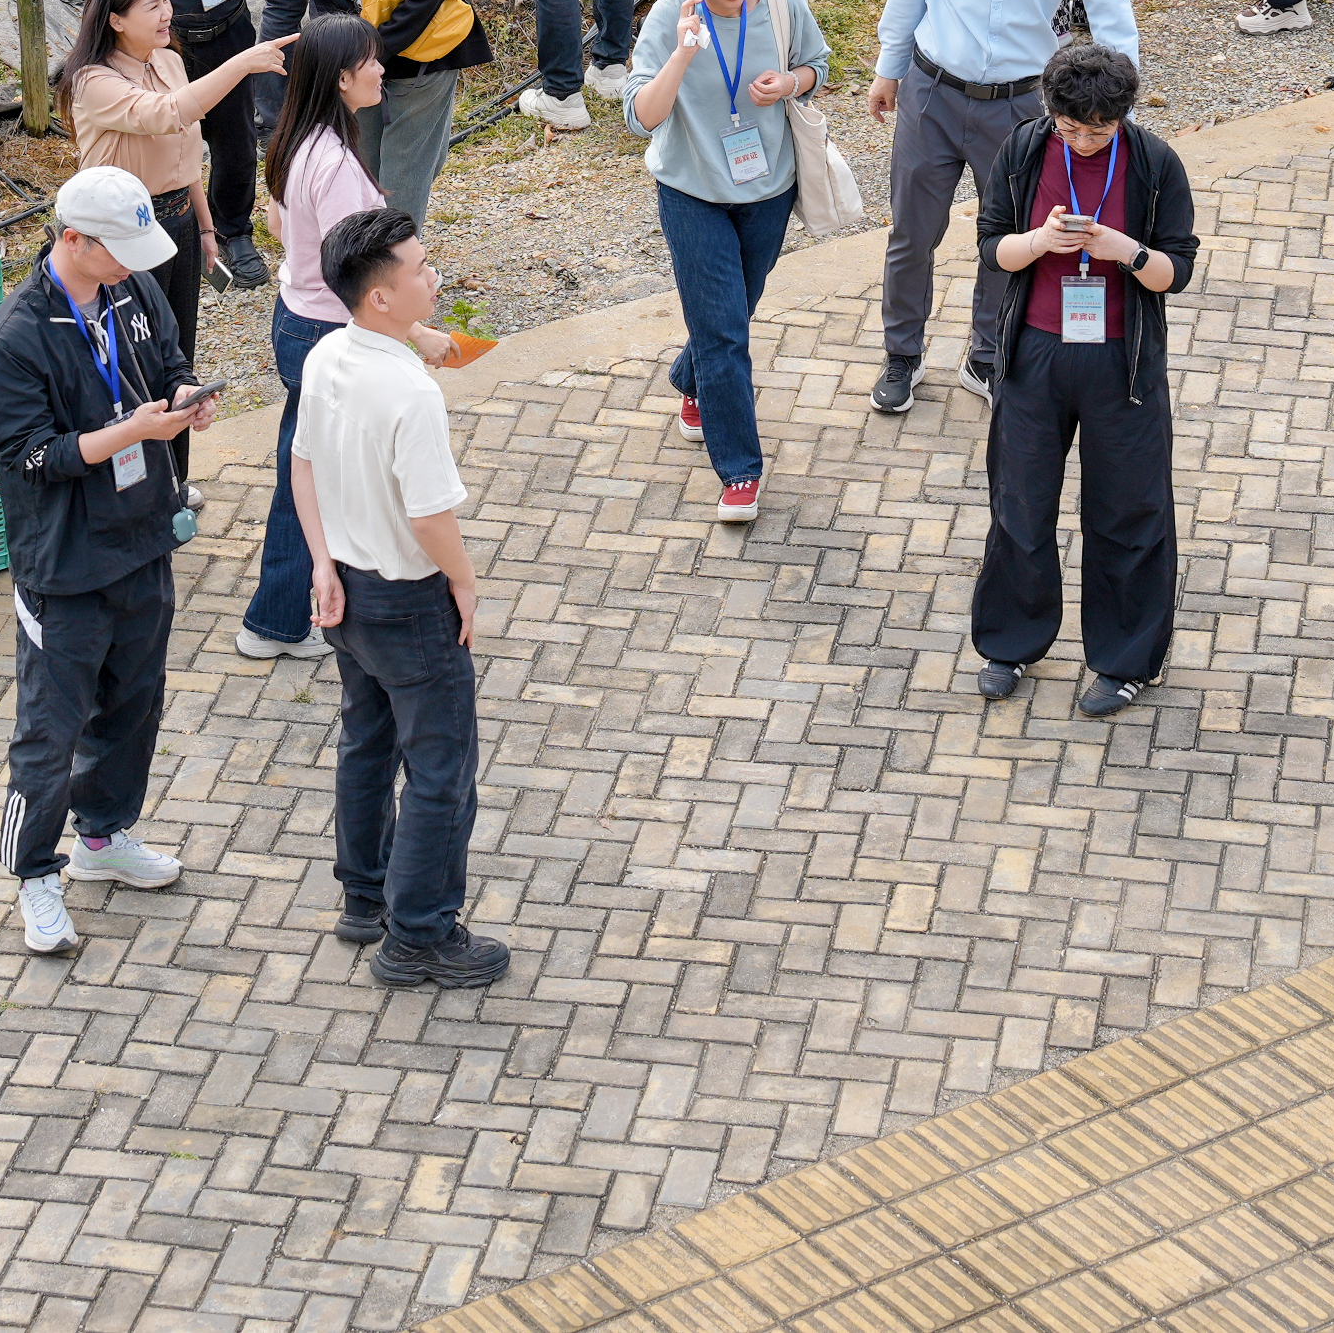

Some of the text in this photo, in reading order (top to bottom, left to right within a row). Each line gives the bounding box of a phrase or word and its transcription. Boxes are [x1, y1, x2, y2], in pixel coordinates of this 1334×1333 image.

[136, 202, 152, 227] NY
[130, 312, 151, 342] NY
[1069, 312, 1097, 321] 嘉宾证
